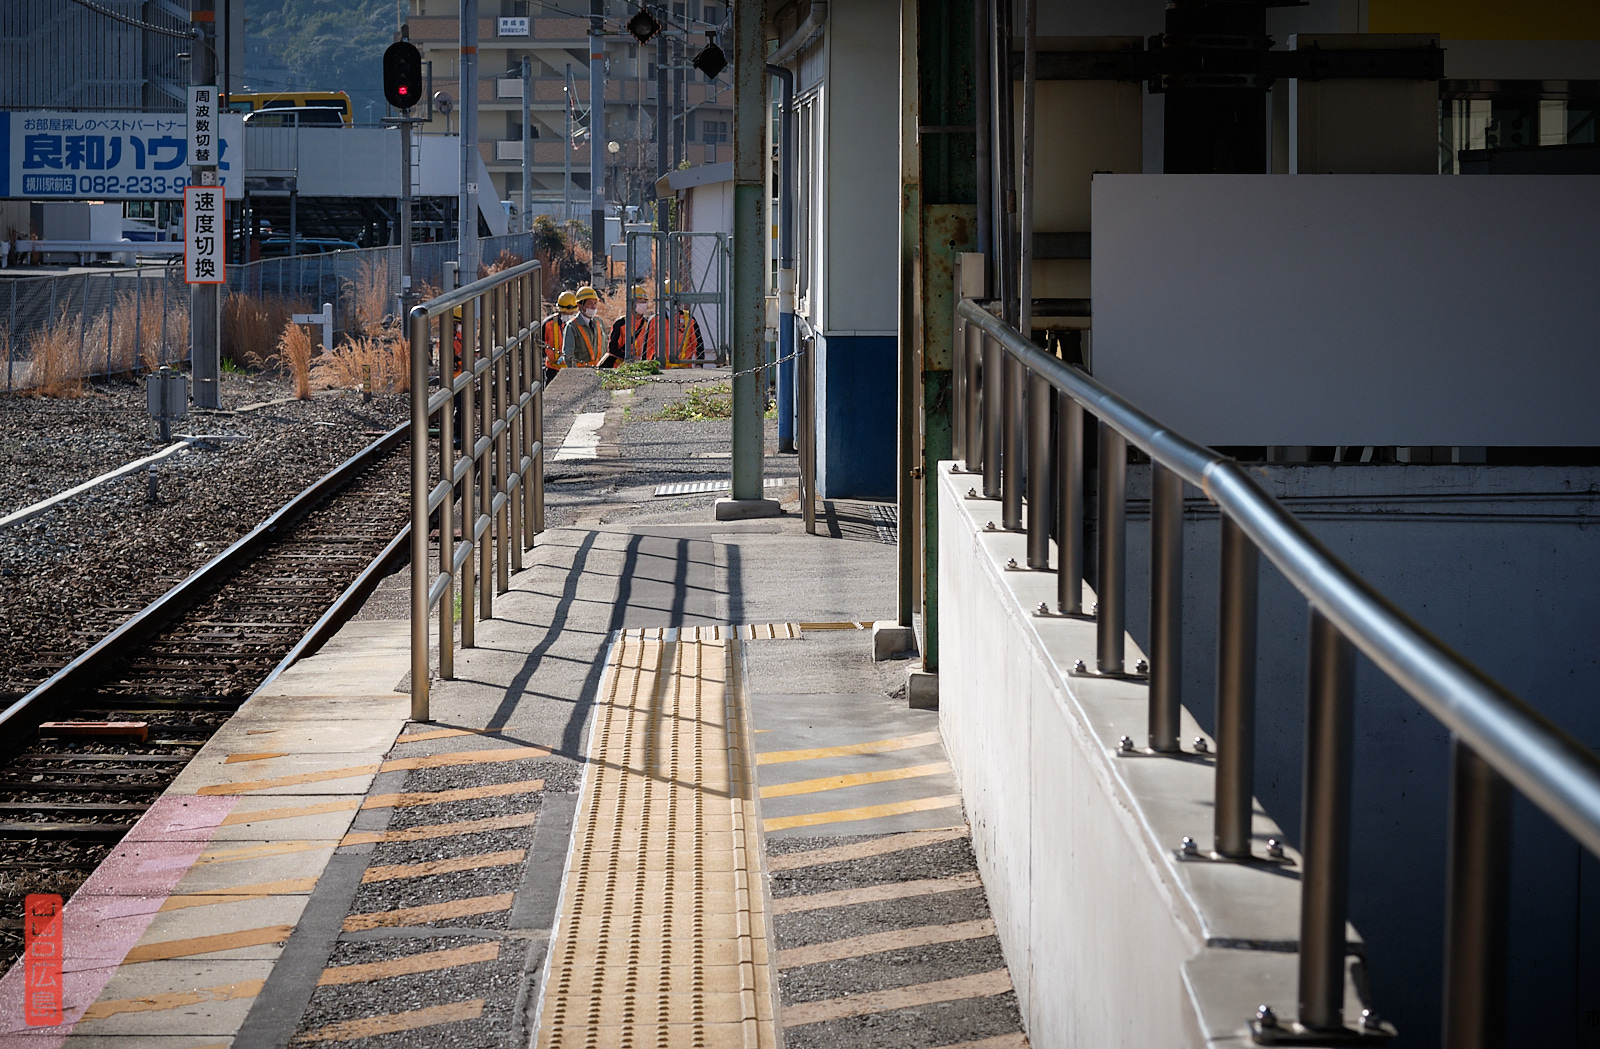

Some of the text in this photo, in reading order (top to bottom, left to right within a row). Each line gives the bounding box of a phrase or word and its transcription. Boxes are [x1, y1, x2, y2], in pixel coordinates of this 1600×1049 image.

[24, 118, 187, 132] お部屋探しのベストパートナー
[195, 90, 210, 161] 周波数切替
[26, 177, 73, 192] 横川駅前店
[195, 192, 215, 278] 速度切換
